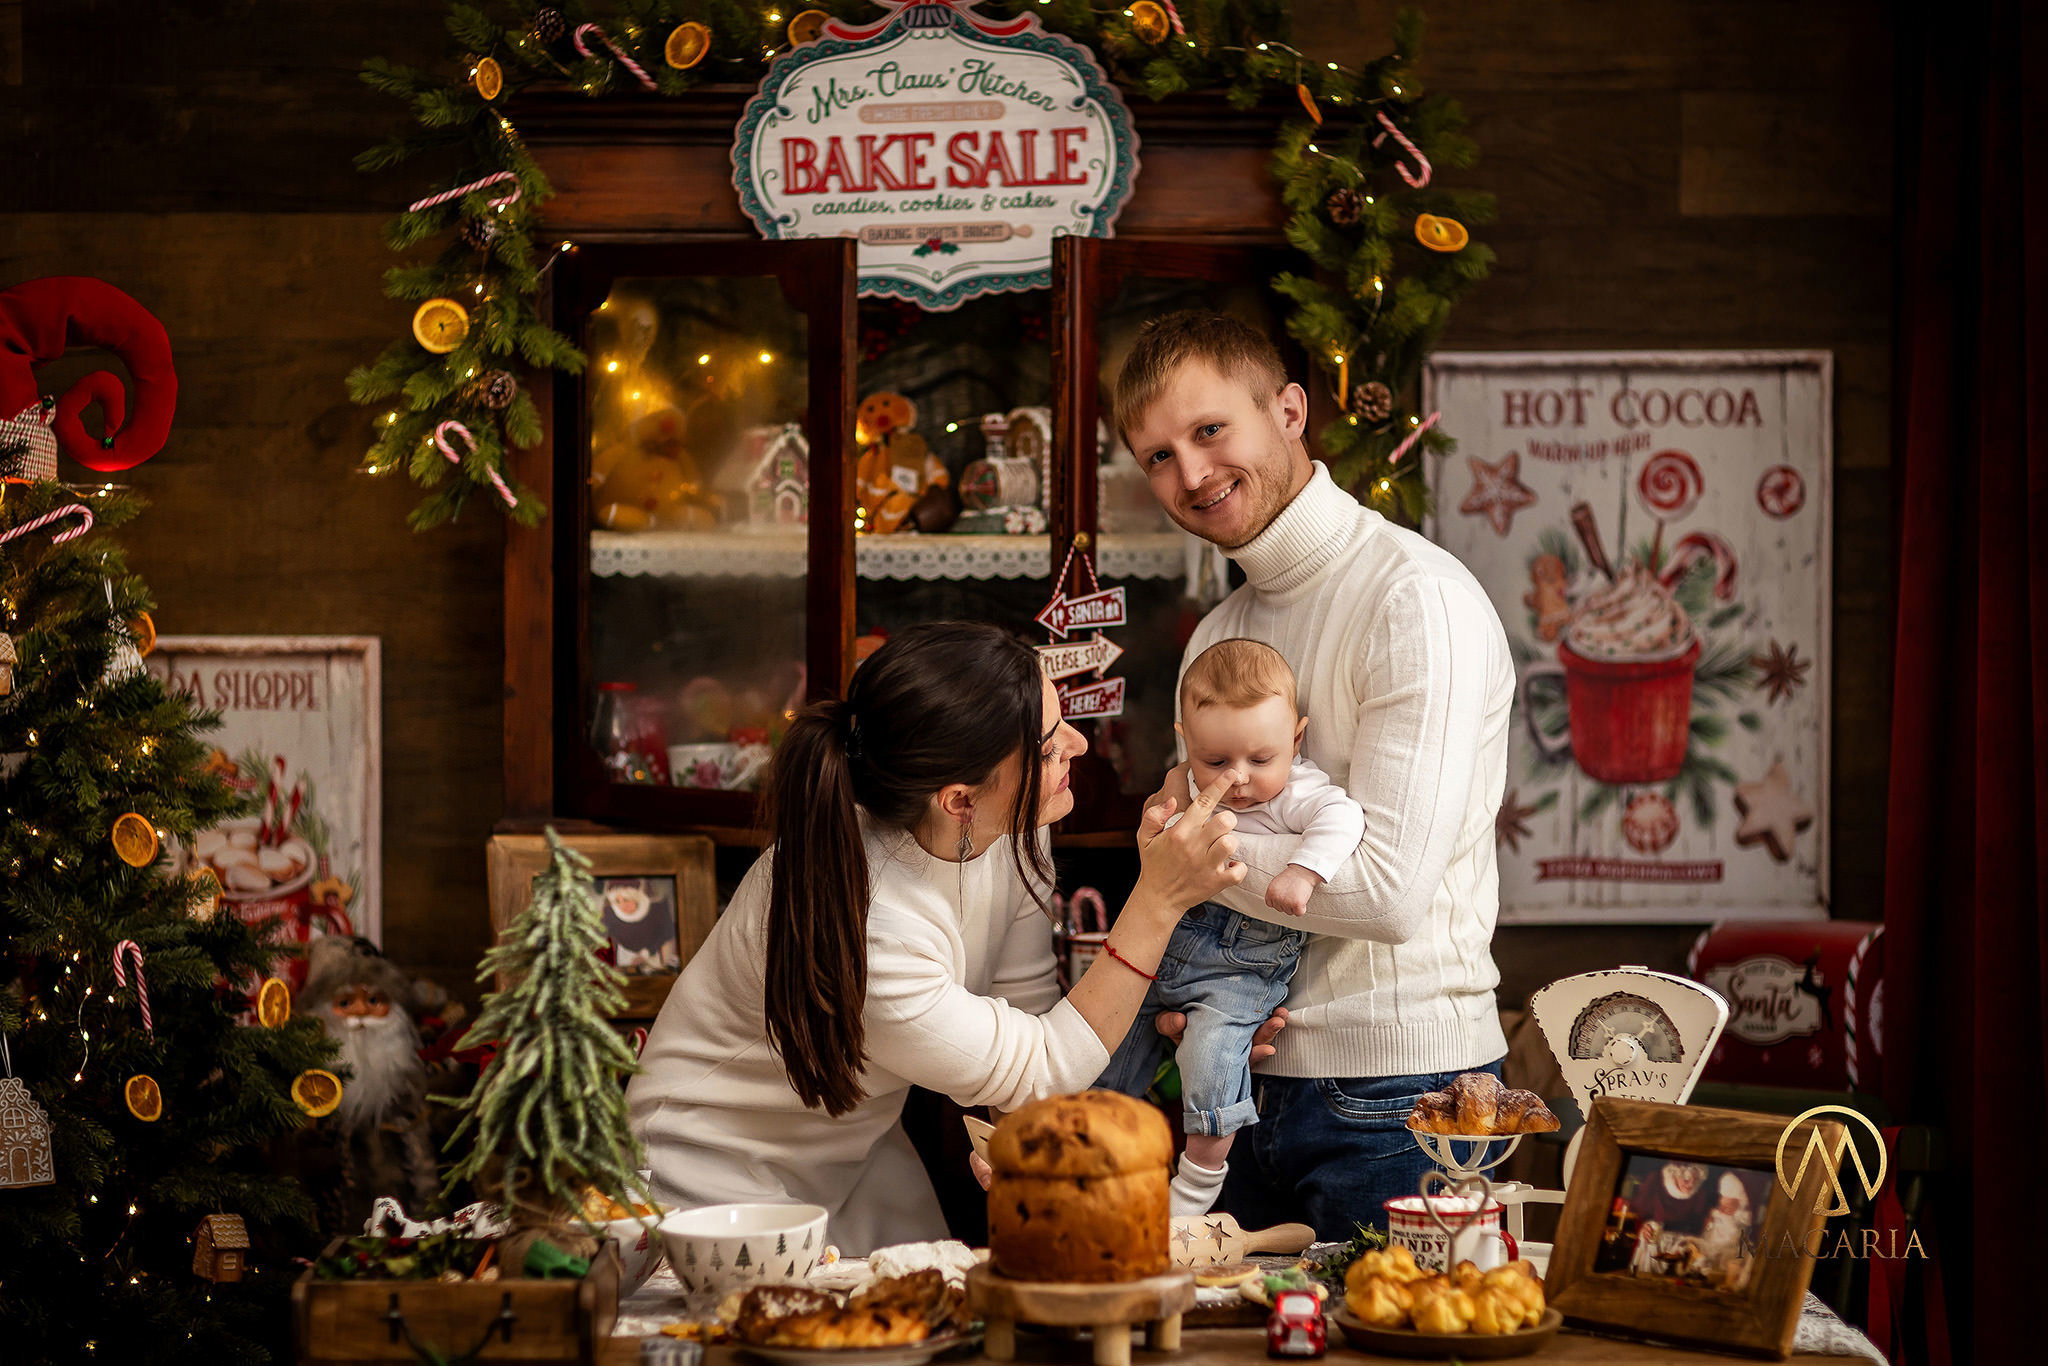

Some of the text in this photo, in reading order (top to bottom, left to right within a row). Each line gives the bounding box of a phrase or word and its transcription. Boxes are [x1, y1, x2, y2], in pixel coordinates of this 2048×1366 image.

[807, 78, 874, 124] Mrs.
[957, 59, 1058, 111] Kitchen
[782, 127, 1088, 194] BAKE SALE
[899, 194, 974, 213] cookies
[999, 191, 1056, 209] cakes
[1502, 386, 1764, 428] HOT COCOA
[1068, 601, 1105, 624] SANTA
[1044, 643, 1110, 672] PLEASE STOP
[1727, 973, 1803, 1026] Santa
